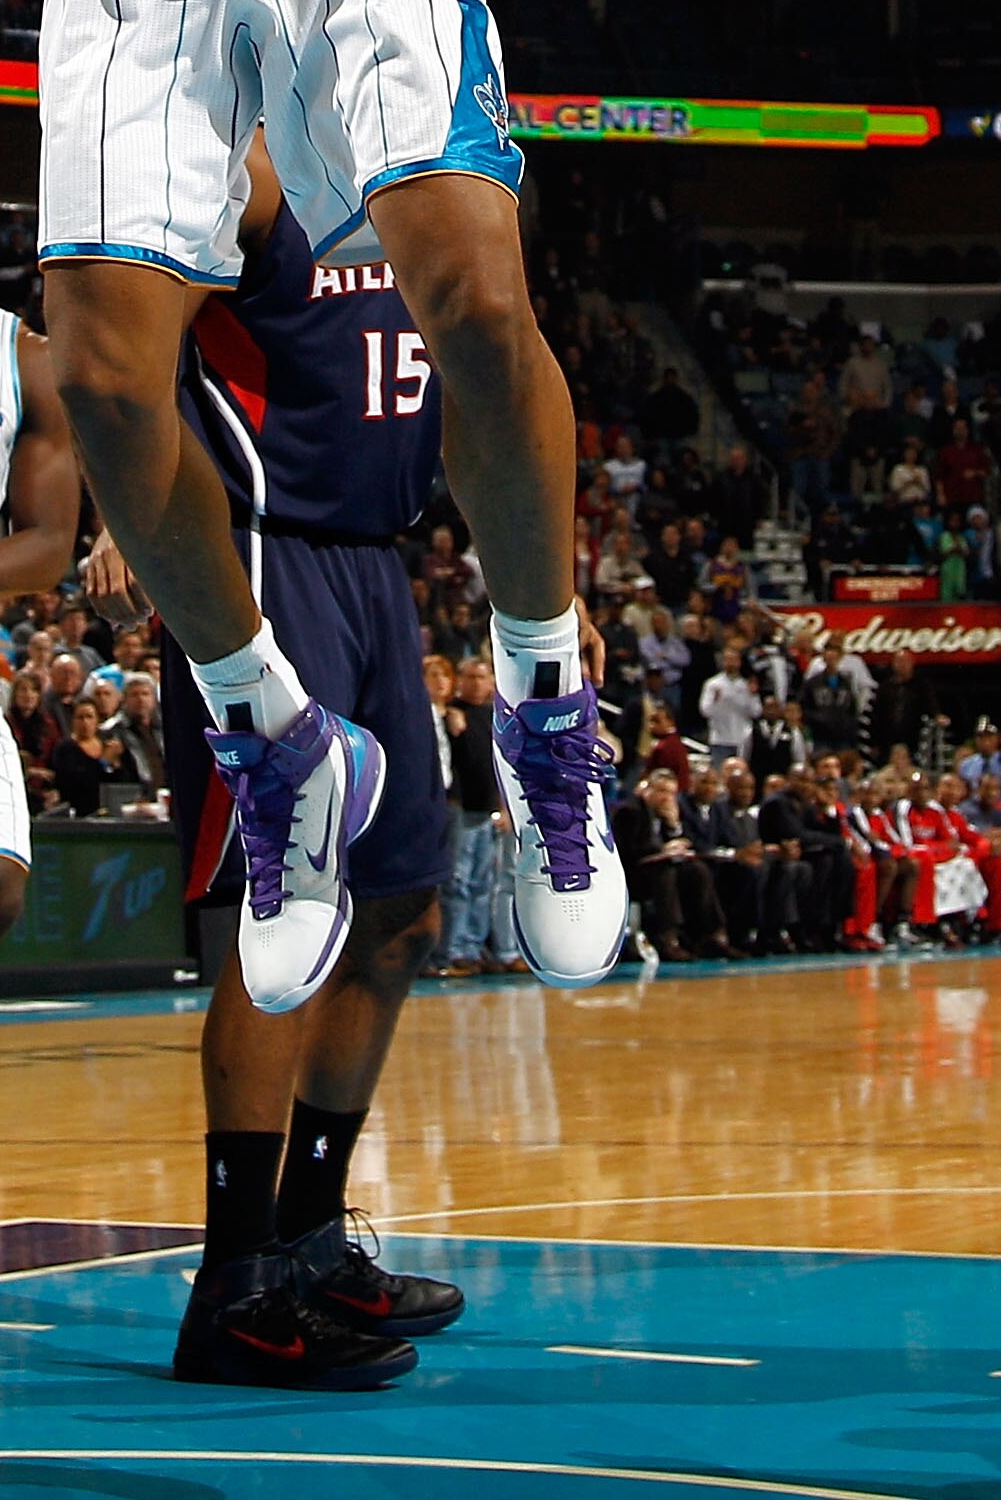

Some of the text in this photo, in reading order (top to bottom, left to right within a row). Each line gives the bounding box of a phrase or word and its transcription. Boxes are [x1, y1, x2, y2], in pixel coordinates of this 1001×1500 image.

[556, 102, 690, 136] CENTER
[361, 329, 432, 420] 15
[541, 708, 581, 732] NIKE
